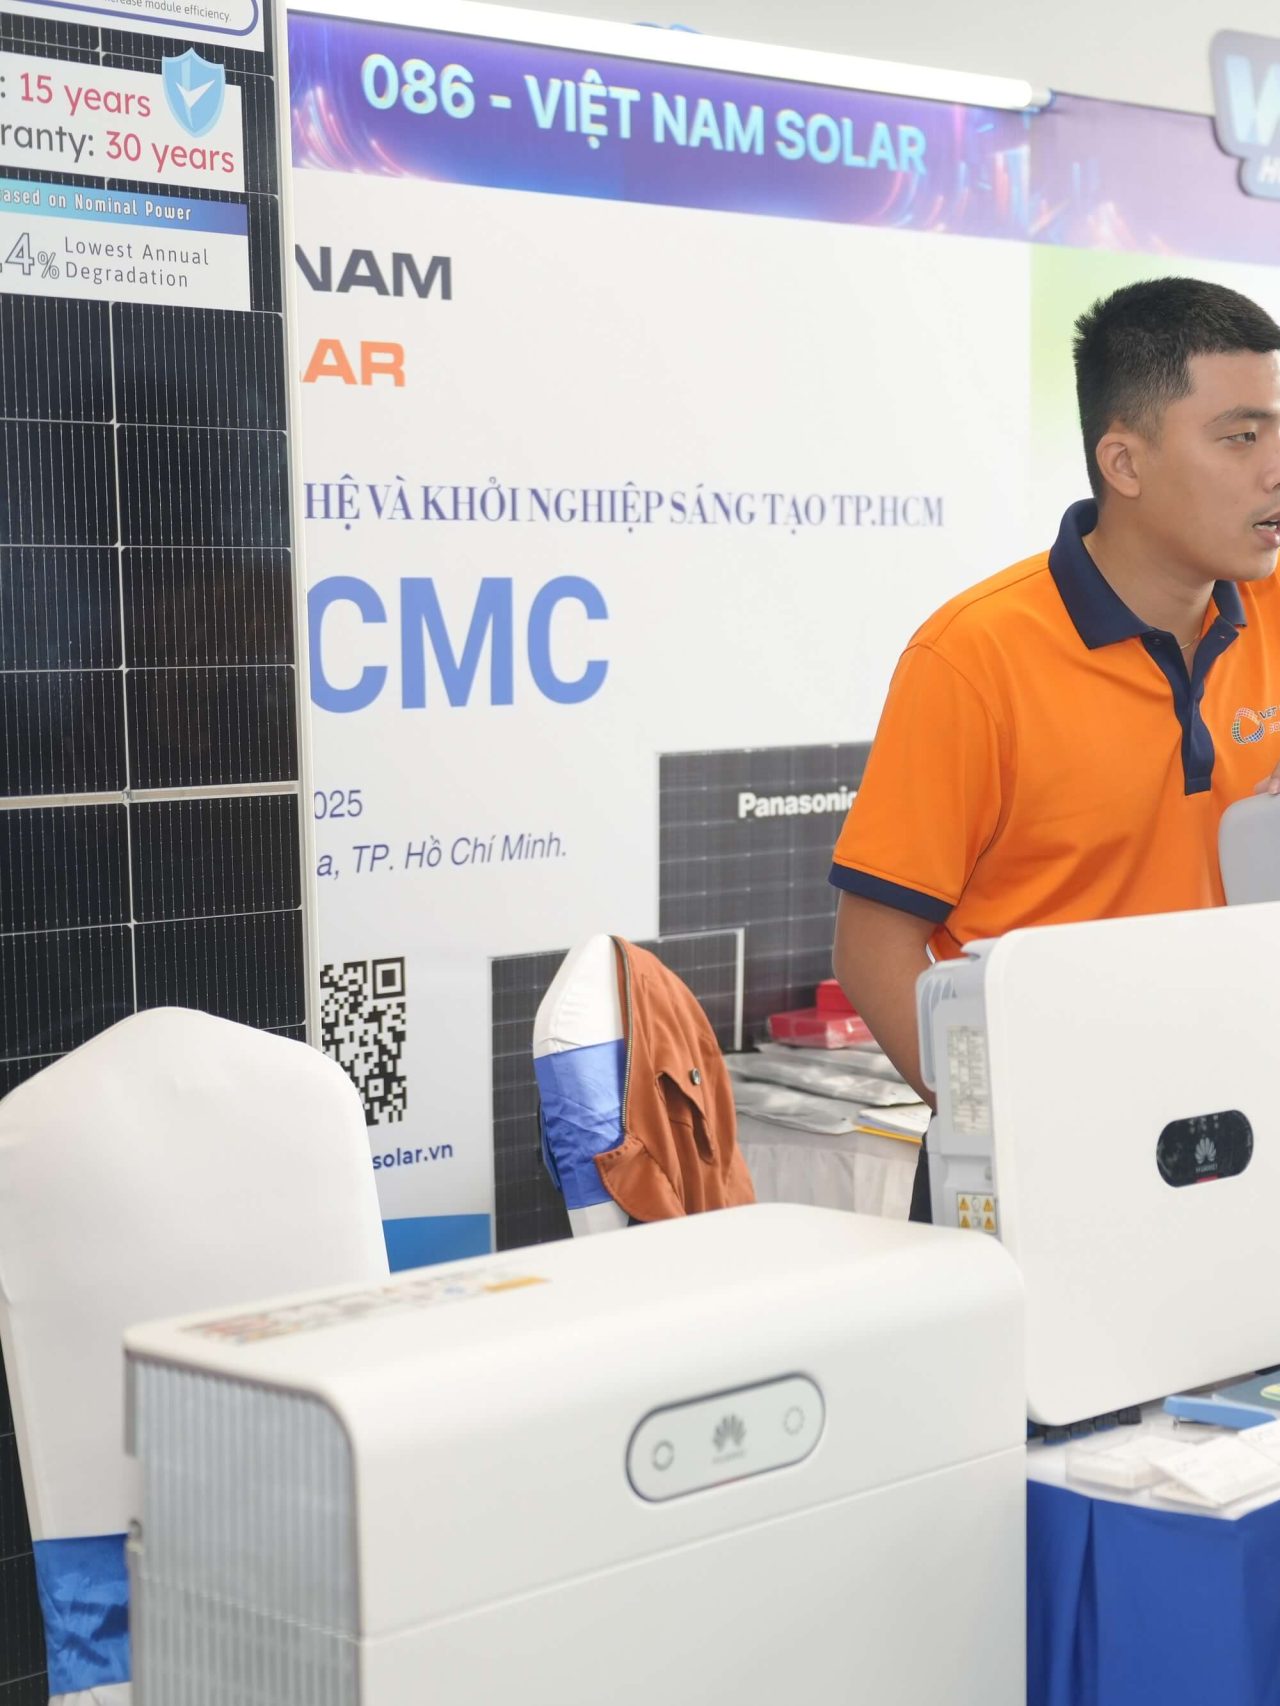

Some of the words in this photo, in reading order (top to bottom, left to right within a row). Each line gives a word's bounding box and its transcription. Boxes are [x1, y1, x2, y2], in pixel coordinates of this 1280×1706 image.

[145, 0, 181, 13] module
[184, 4, 232, 22] efficiency.
[20, 72, 53, 104] 15
[64, 84, 152, 118] years
[361, 53, 476, 119] 086
[523, 68, 641, 150] VIỆT
[651, 91, 765, 156] NAM
[774, 108, 927, 176] SOLAR
[105, 130, 142, 162] 30
[152, 142, 235, 174] years
[0, 188, 41, 207] ased
[49, 195, 67, 209] on
[75, 193, 138, 216] Nominal
[145, 200, 193, 221] Power
[0, 231, 61, 280] 4%
[65, 236, 133, 258] Lowest
[142, 243, 209, 266] Annual
[66, 261, 188, 288] Degradation
[295, 243, 453, 301] NAM
[299, 338, 406, 387] AR
[304, 473, 361, 530] HỆ
[365, 474, 415, 520] VÀ
[420, 476, 521, 522] KHỞI
[528, 481, 664, 533] NGHIỆP
[669, 483, 757, 525] SÁNG
[762, 492, 827, 535] TẠO
[832, 493, 945, 528] TP.HCM
[306, 574, 610, 714] CMC
[352, 843, 394, 873] TP.
[404, 834, 443, 869] Hồ
[451, 834, 496, 866] Chí
[501, 831, 567, 862] Minh.
[372, 1143, 454, 1171] solar.vn
